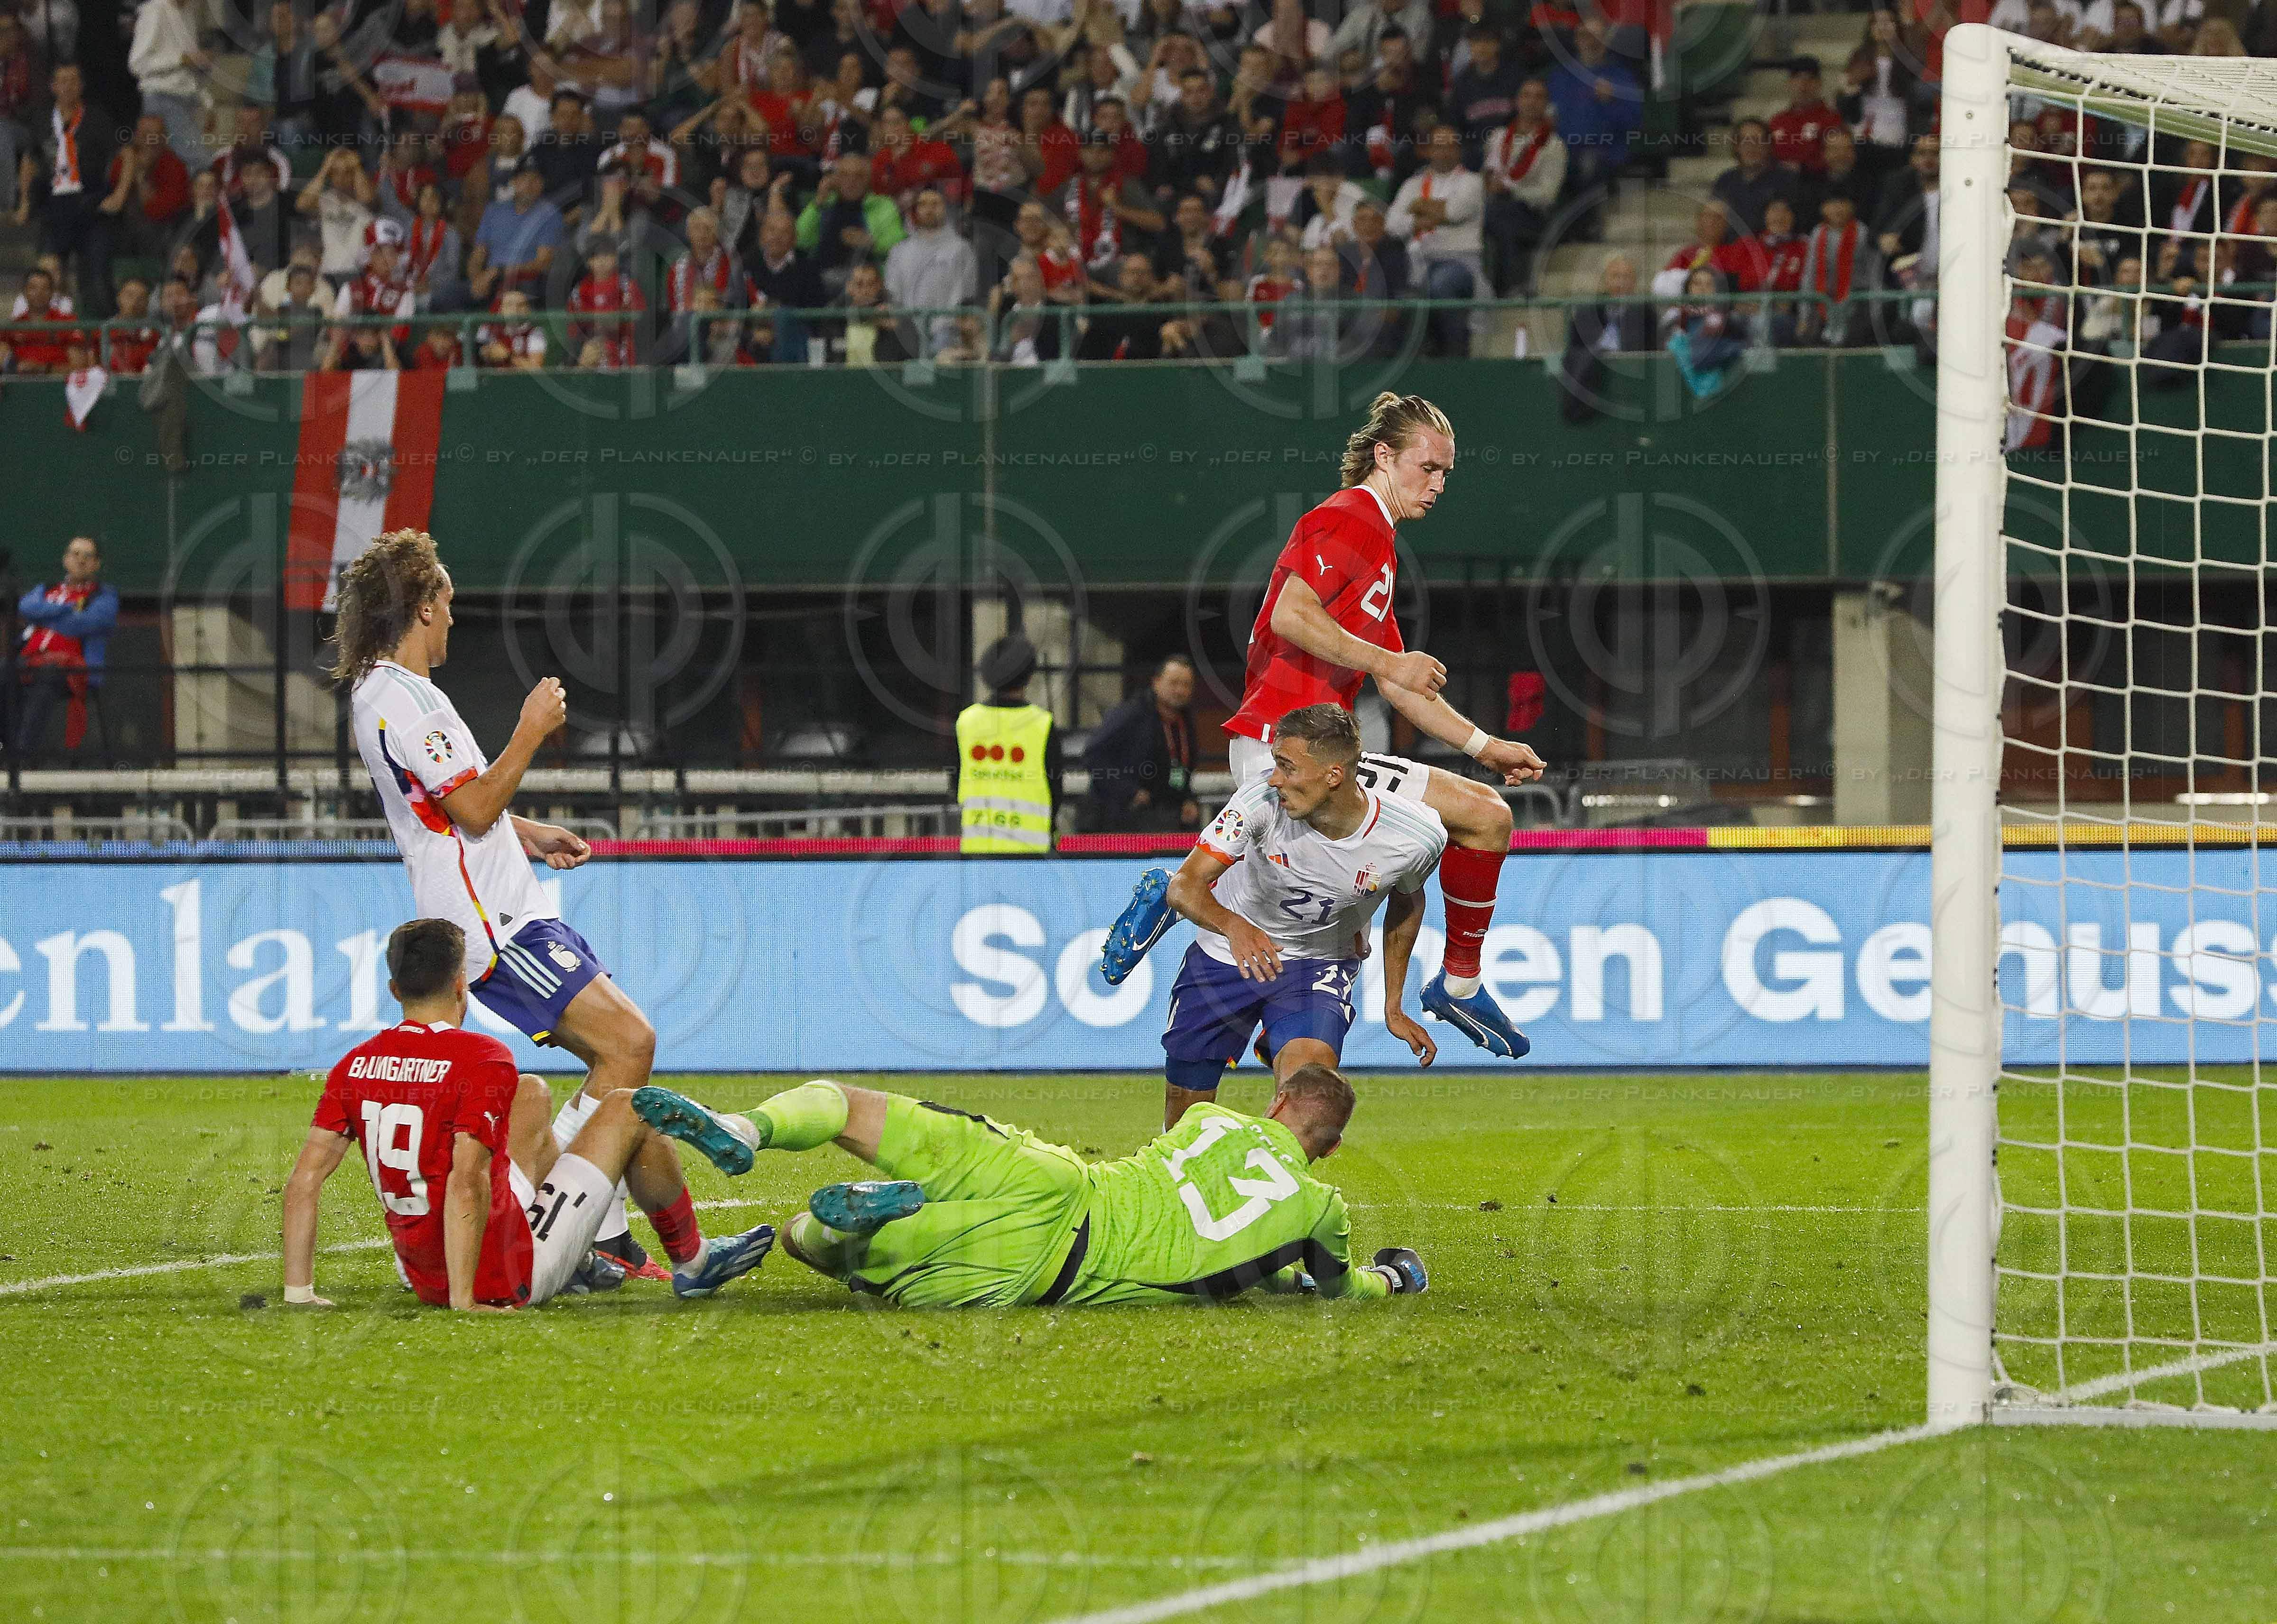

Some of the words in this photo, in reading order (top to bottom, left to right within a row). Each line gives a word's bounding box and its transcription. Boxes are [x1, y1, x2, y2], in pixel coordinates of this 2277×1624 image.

[1279, 886, 1336, 925] 21
[1722, 896, 2277, 1022] Genus
[348, 1056, 453, 1083] BAUMGARTNER
[361, 1099, 430, 1216] 19
